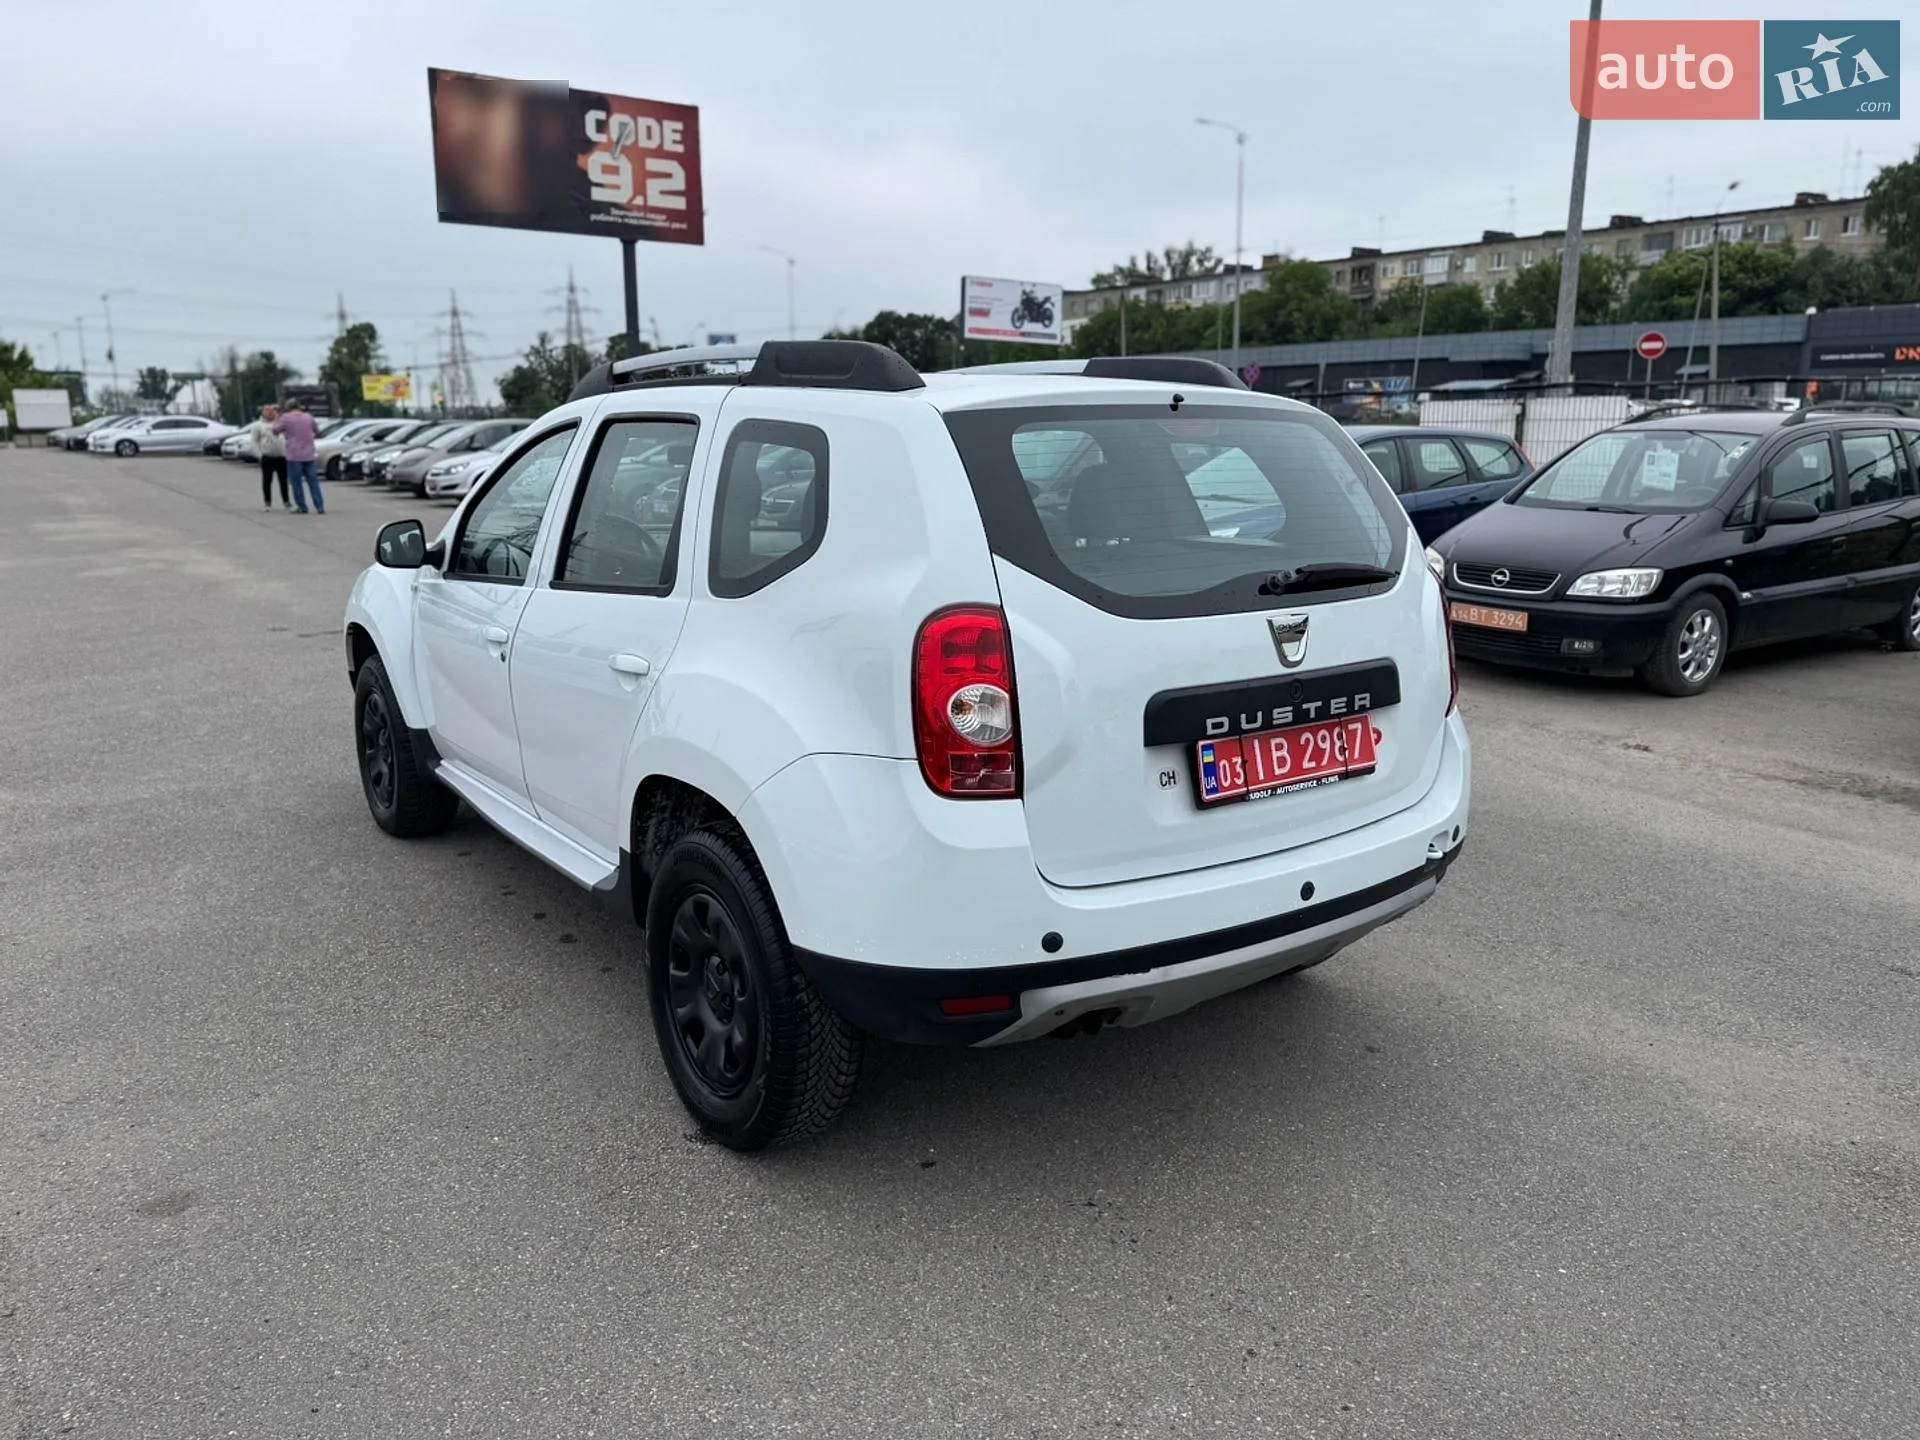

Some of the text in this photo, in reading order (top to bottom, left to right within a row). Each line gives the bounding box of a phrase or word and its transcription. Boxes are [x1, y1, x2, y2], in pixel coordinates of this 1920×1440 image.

[585, 109, 685, 153] CODE
[587, 151, 687, 210] 9.2
[1491, 611, 1523, 628] 3294
[1205, 693, 1371, 735] DUSTER
[1204, 722, 1363, 789] UA 03 IB 2987
[1159, 770, 1176, 787] CH
[1276, 780, 1317, 795] AUTOSERVICE
